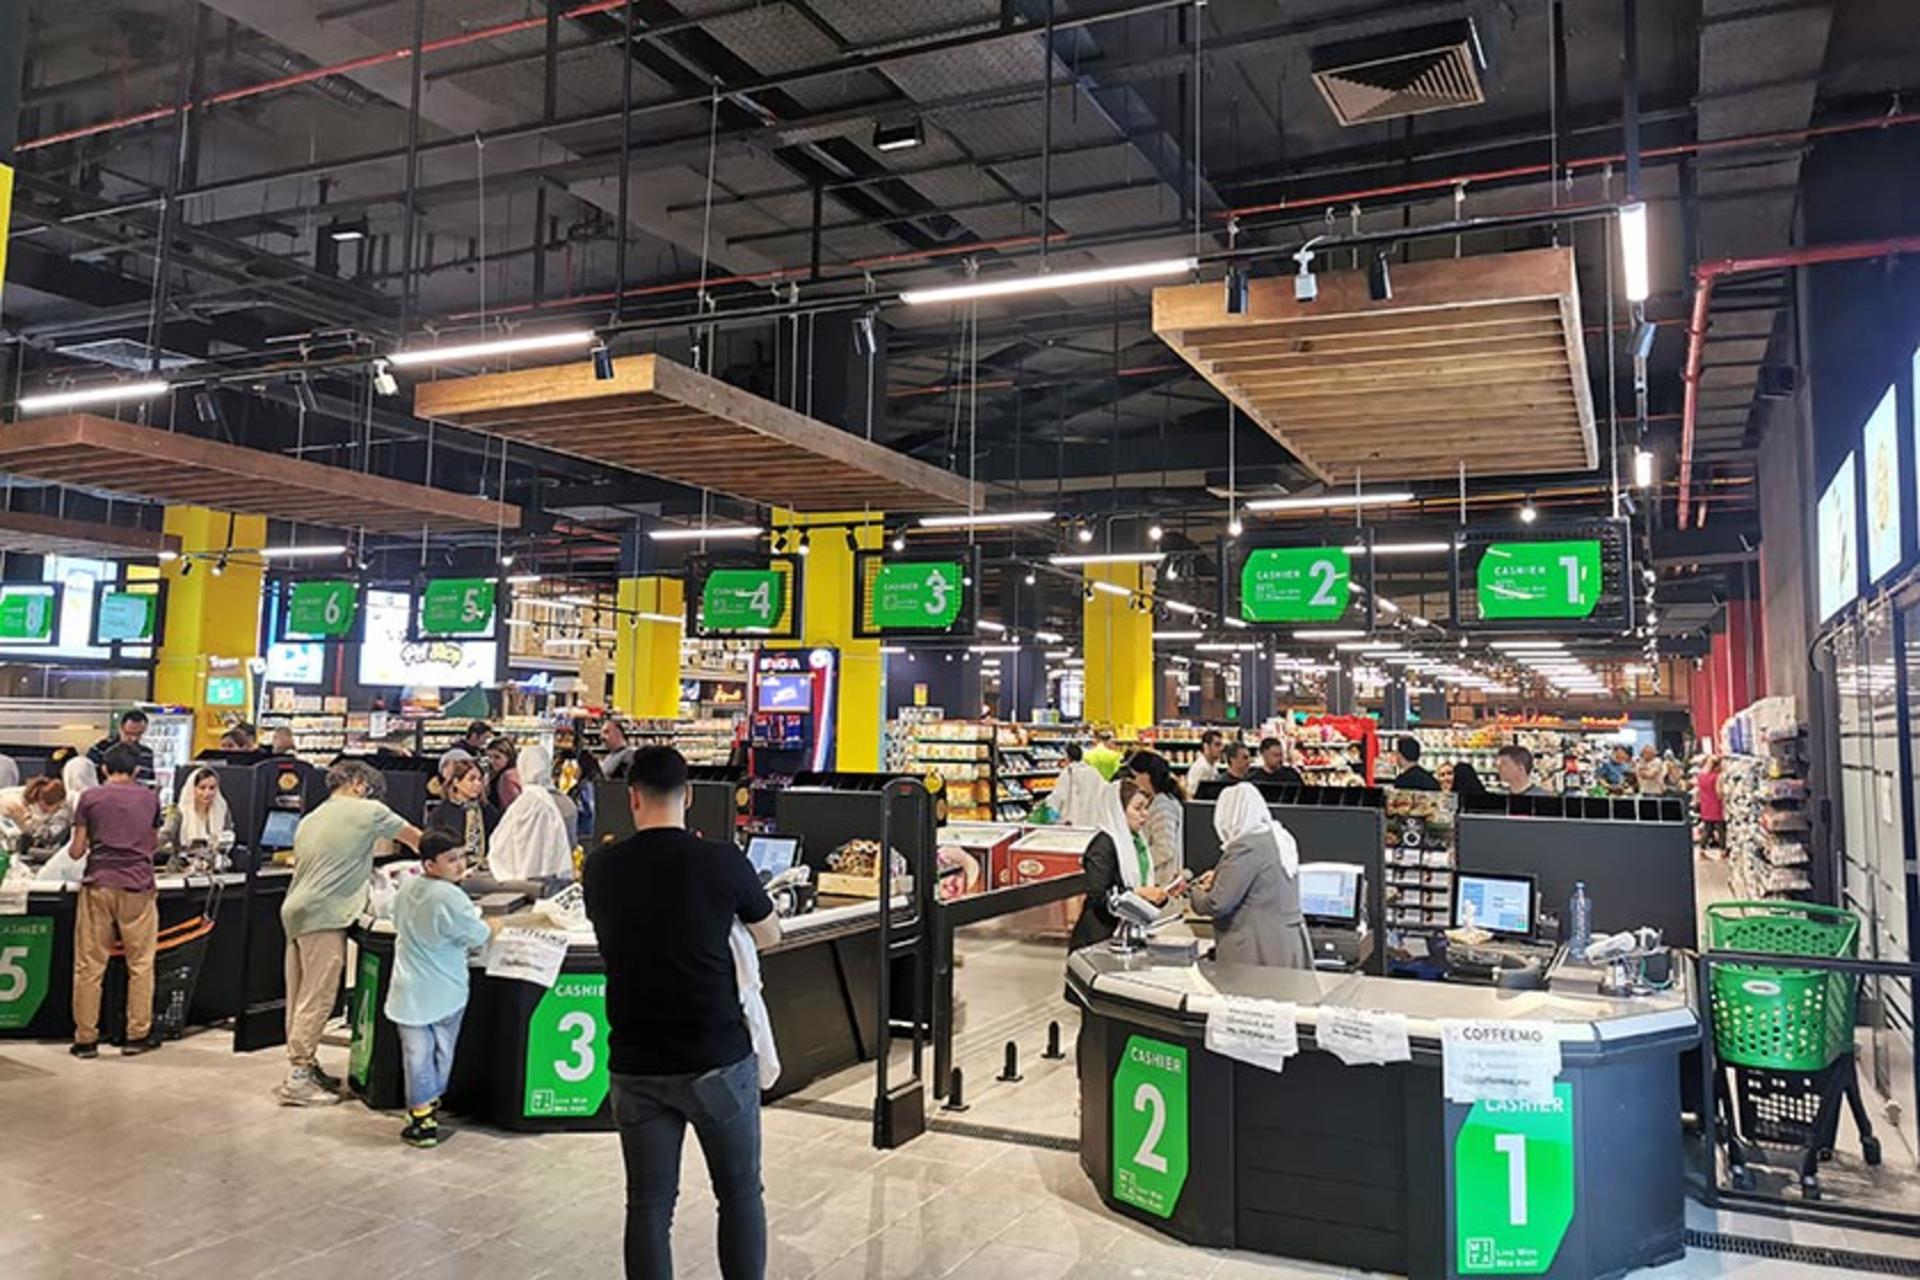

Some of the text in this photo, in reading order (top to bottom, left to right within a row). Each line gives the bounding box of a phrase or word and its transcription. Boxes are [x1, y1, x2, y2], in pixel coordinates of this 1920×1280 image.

[1257, 570, 1300, 580] CASHIER
[1309, 560, 1337, 606] 2
[1494, 566, 1546, 576] CASHIER
[1558, 555, 1579, 604] 1
[324, 591, 341, 624] 6
[462, 588, 480, 623] 5
[750, 581, 771, 619] 4
[924, 573, 947, 615] 3
[25, 601, 37, 631] 8
[0, 924, 48, 935] ASHIER
[0, 946, 28, 1002] 5
[555, 984, 605, 998] CASHIE
[554, 1011, 597, 1082] 3
[1131, 1046, 1183, 1074] CASHIER
[1133, 1083, 1168, 1173] 2
[1494, 1134, 1528, 1226] 1
